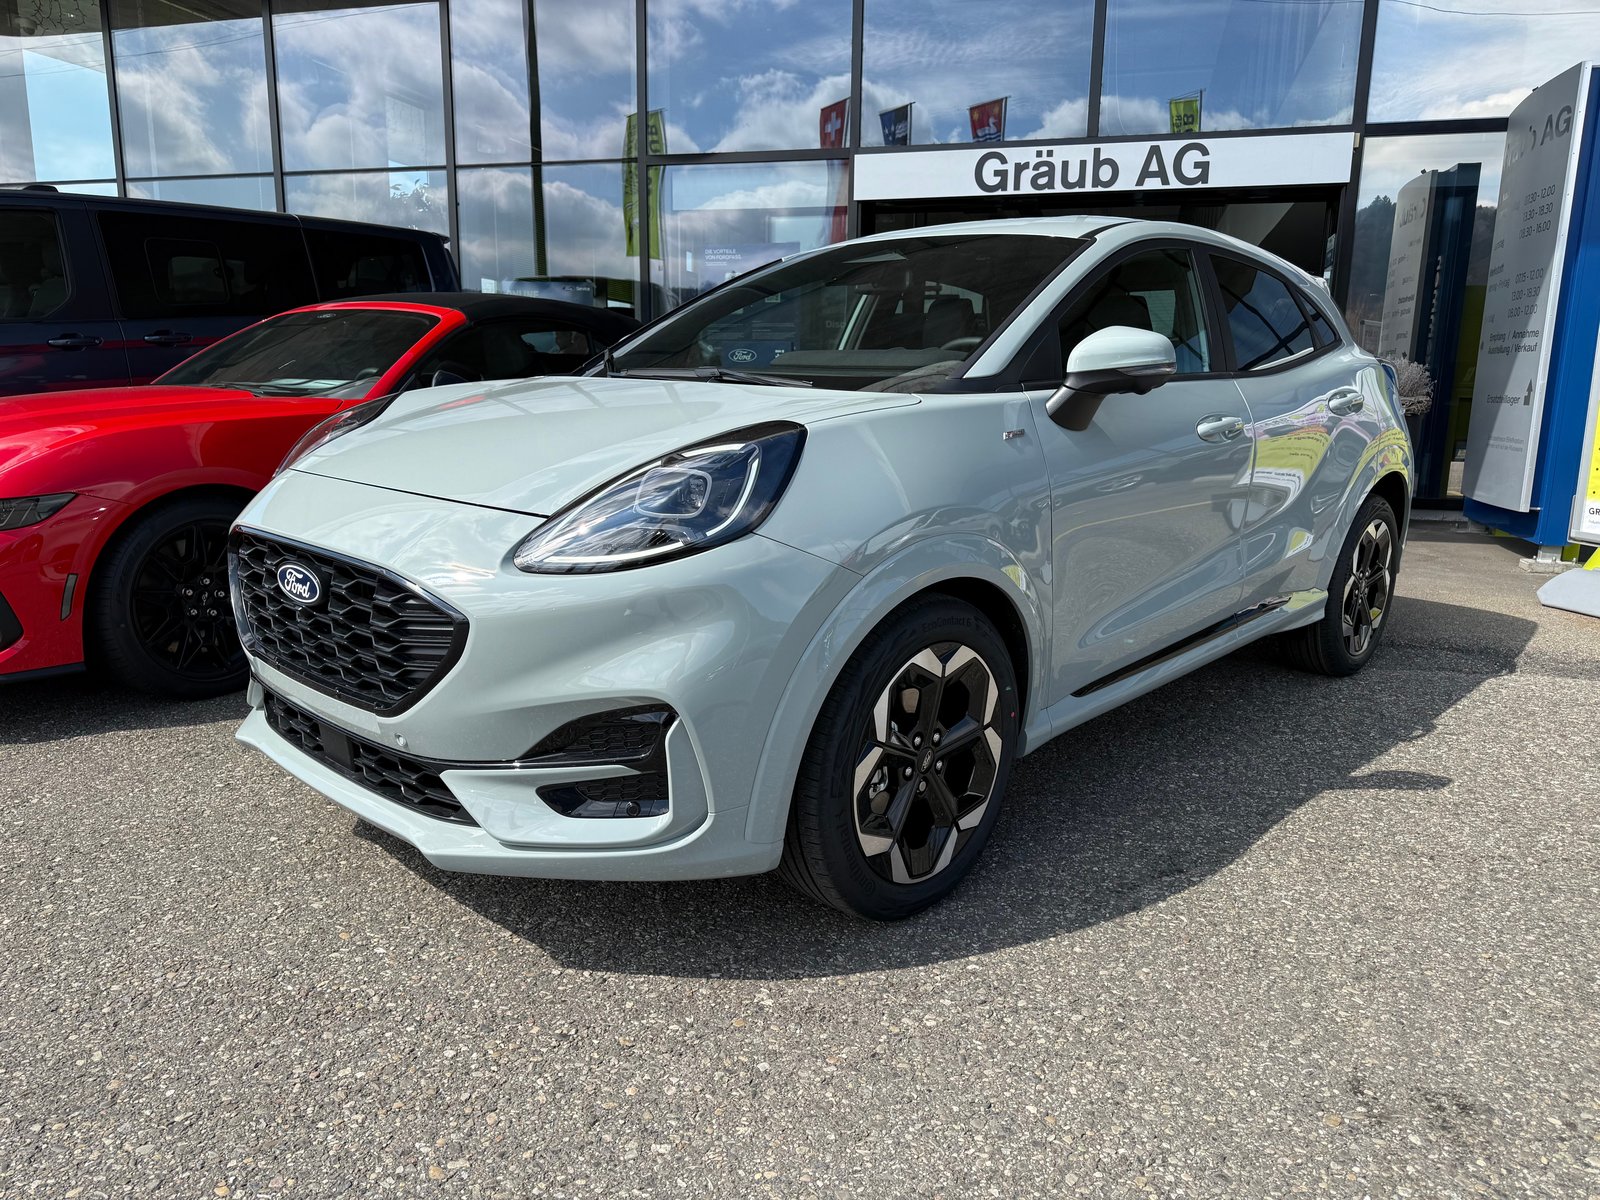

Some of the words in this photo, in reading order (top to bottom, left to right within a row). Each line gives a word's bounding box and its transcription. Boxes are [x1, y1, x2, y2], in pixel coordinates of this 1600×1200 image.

[1541, 105, 1572, 146] AG
[974, 148, 1120, 193] Gräub
[1135, 142, 1211, 187] AG
[733, 351, 753, 361] Ford
[1514, 342, 1537, 353] Verkauf
[283, 567, 312, 600] Ford
